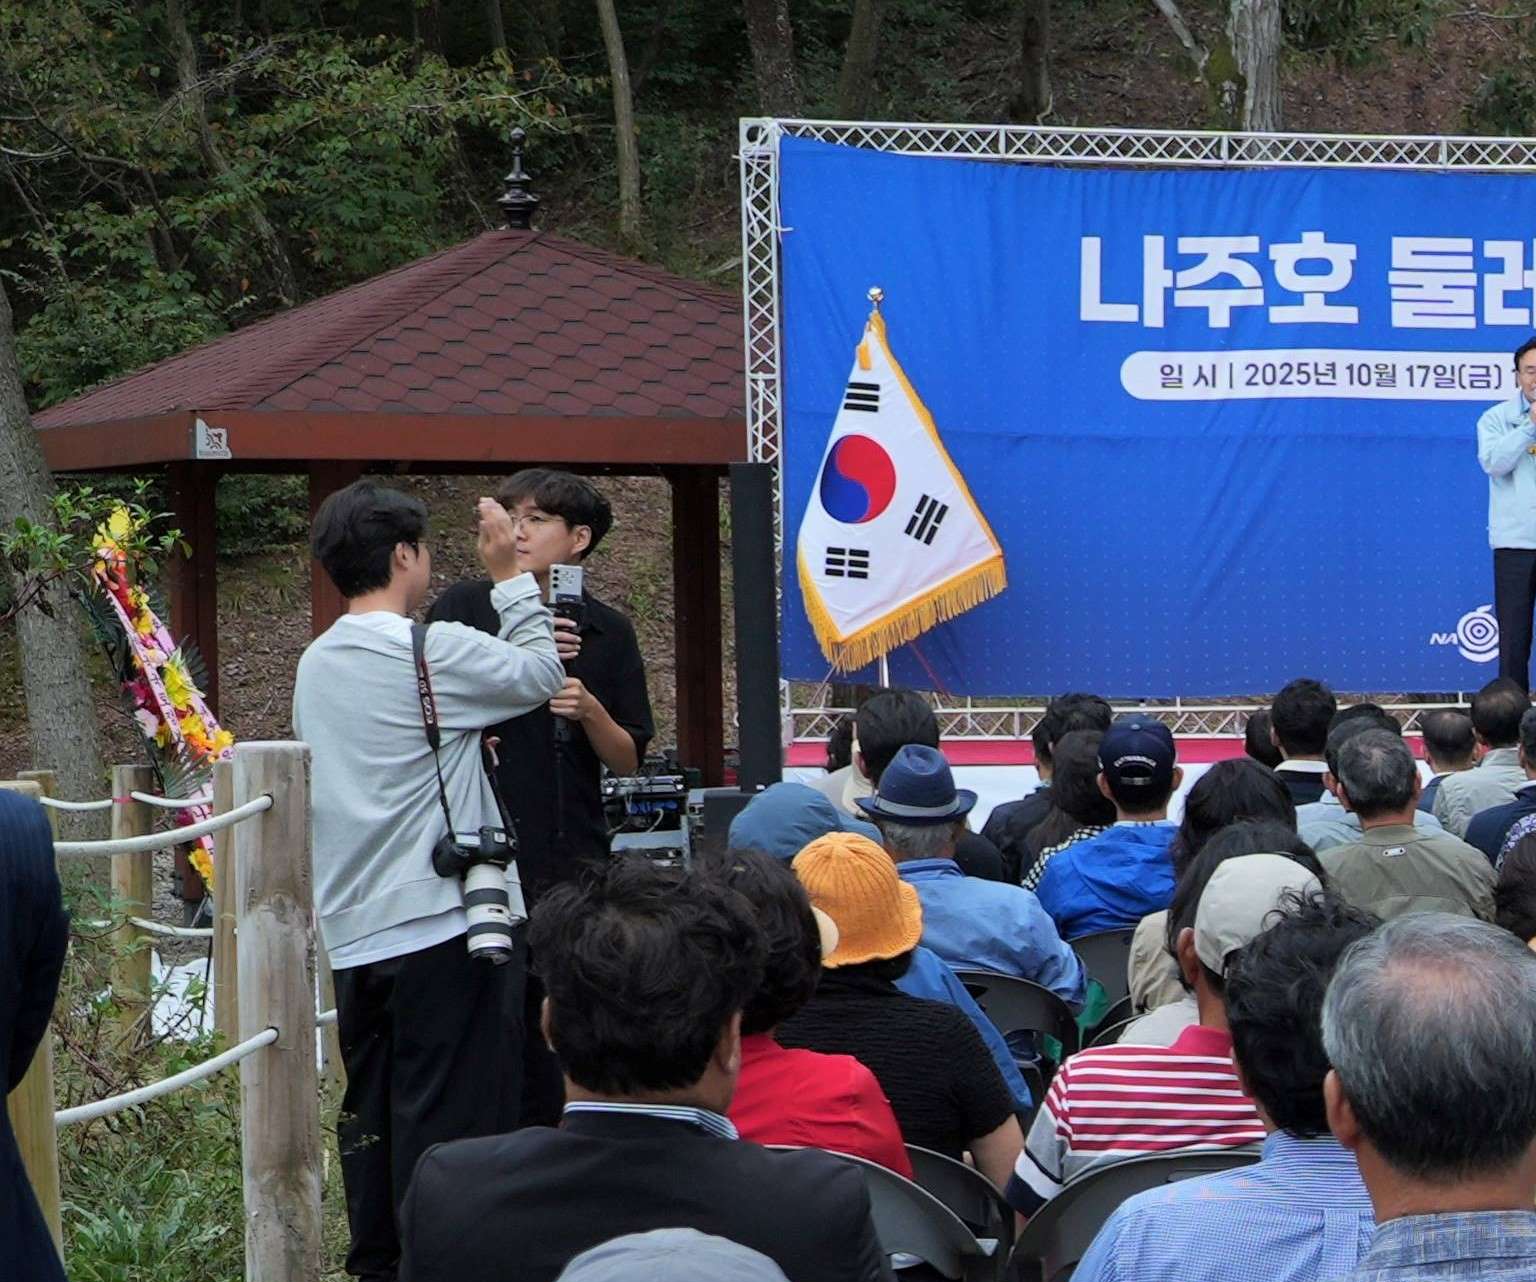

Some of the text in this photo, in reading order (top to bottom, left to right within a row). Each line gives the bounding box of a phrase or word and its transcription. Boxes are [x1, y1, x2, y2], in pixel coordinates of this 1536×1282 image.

[1079, 230, 1360, 329] 나주호
[1159, 363, 1184, 390] 일
[1192, 363, 1217, 390] 시
[1243, 361, 1338, 388] 2025년
[1344, 362, 1398, 389] 10월
[1404, 362, 1503, 391] 17일(금)
